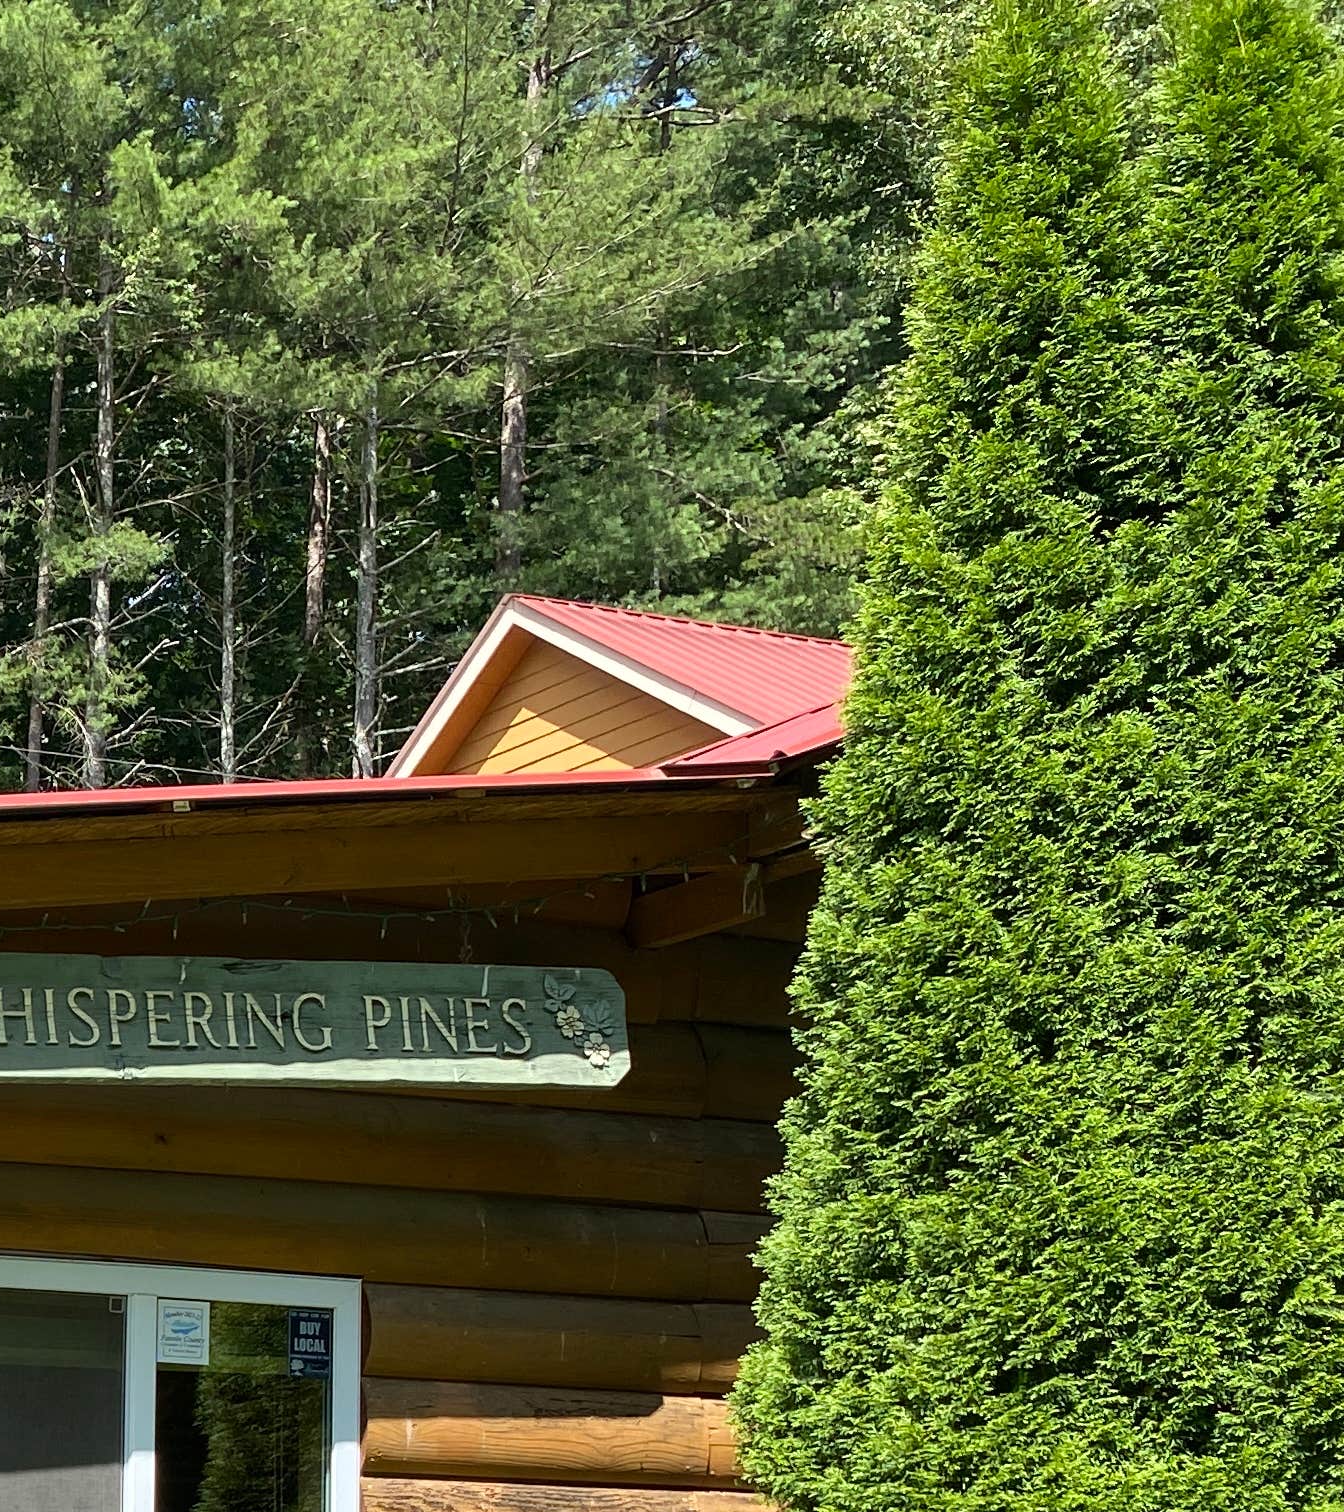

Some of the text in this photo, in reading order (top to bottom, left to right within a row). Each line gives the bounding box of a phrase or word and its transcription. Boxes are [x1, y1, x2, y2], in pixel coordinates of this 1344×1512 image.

[364, 993, 534, 1056] PINES
[299, 1321, 321, 1336] BUY
[294, 1337, 326, 1353] LOCAL
